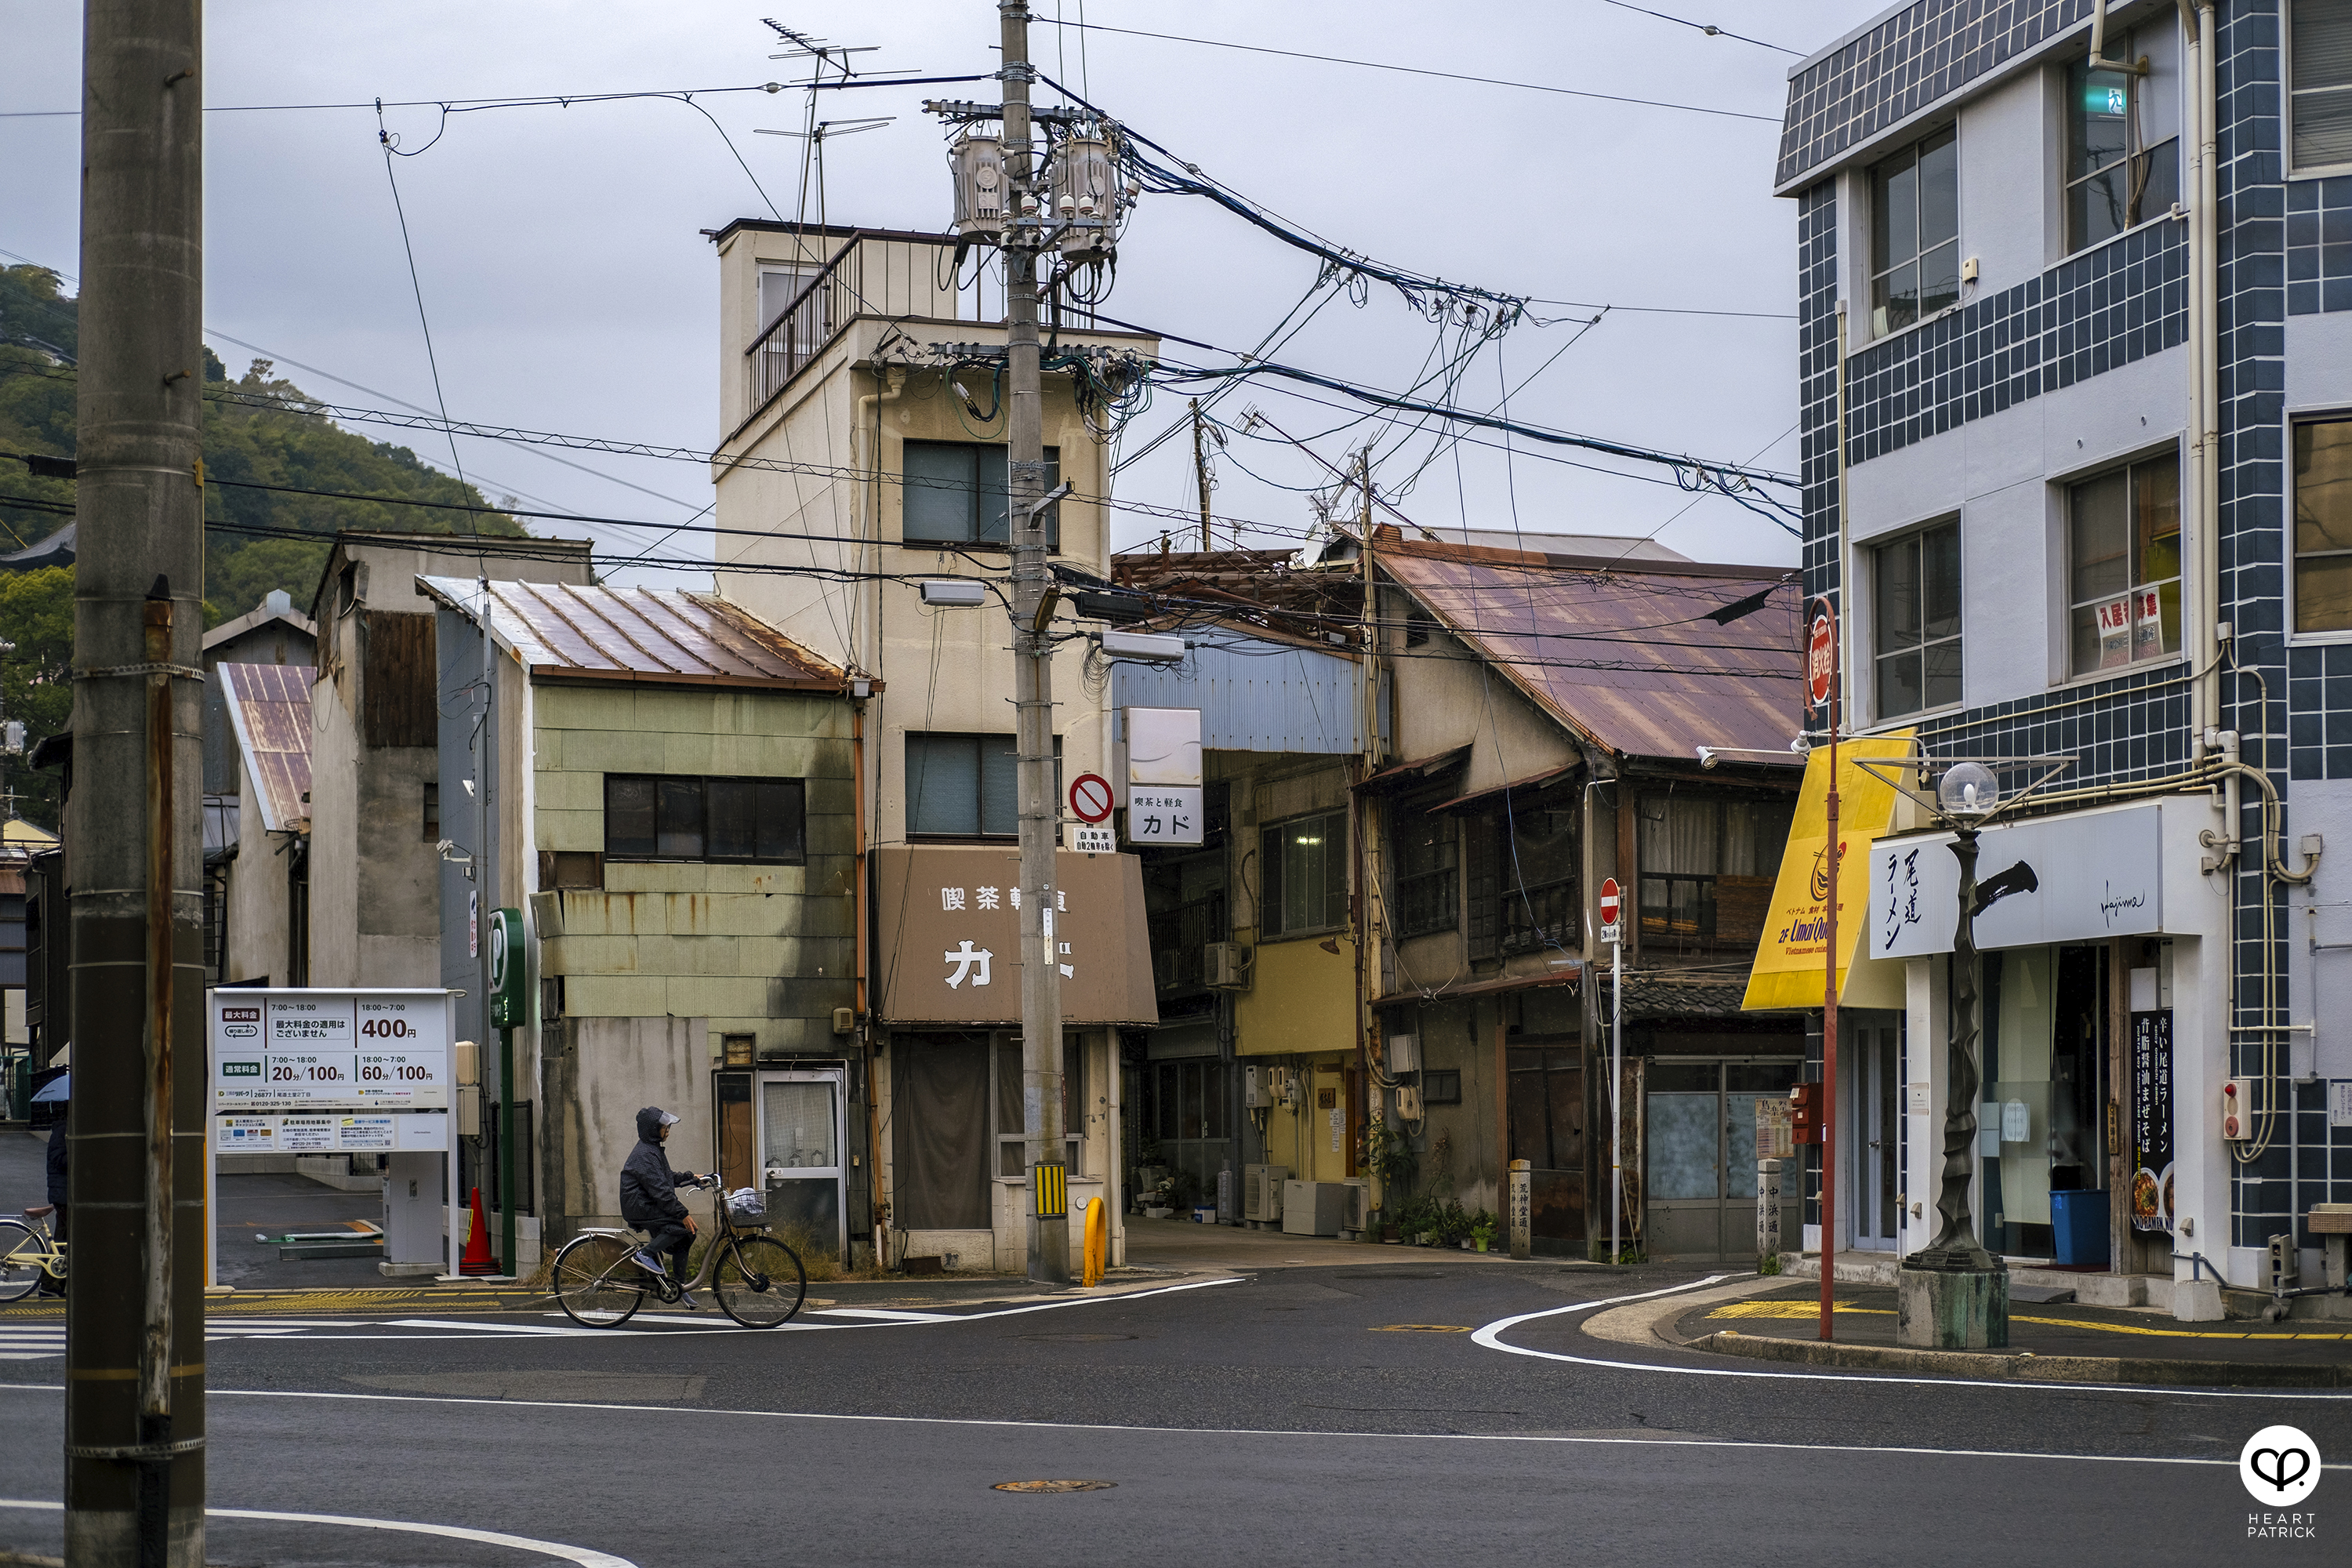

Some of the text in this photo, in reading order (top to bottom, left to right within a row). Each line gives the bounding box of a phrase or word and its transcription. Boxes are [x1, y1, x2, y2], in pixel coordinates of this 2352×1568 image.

[1812, 641, 1830, 681] 消火栓
[1134, 797, 1183, 808] 喫茶と軽食
[1144, 815, 1189, 835] カド
[1080, 832, 1109, 840] 自動車
[1904, 848, 1922, 924] 尾道
[1786, 906, 1805, 916] ベトナム
[1808, 906, 1820, 915] 食材
[1886, 853, 1900, 950] ラーメン
[1778, 928, 1790, 943] 2F
[493, 928, 502, 978] P
[1785, 947, 1813, 956] Vietnamese
[276, 1020, 345, 1029] 最大料金の適用は
[277, 1029, 327, 1038] ございません
[361, 1019, 416, 1038] 400円
[272, 1066, 344, 1081] 20分/100円
[362, 1065, 433, 1080] 60分/100円
[2141, 1018, 2151, 1153] 背脂醤油まぜそば
[2159, 1017, 2168, 1153] 辛い尾道ラーメン
[1519, 1183, 1528, 1237] 荒神堂通り
[1768, 1186, 1779, 1248] 中浜通り
